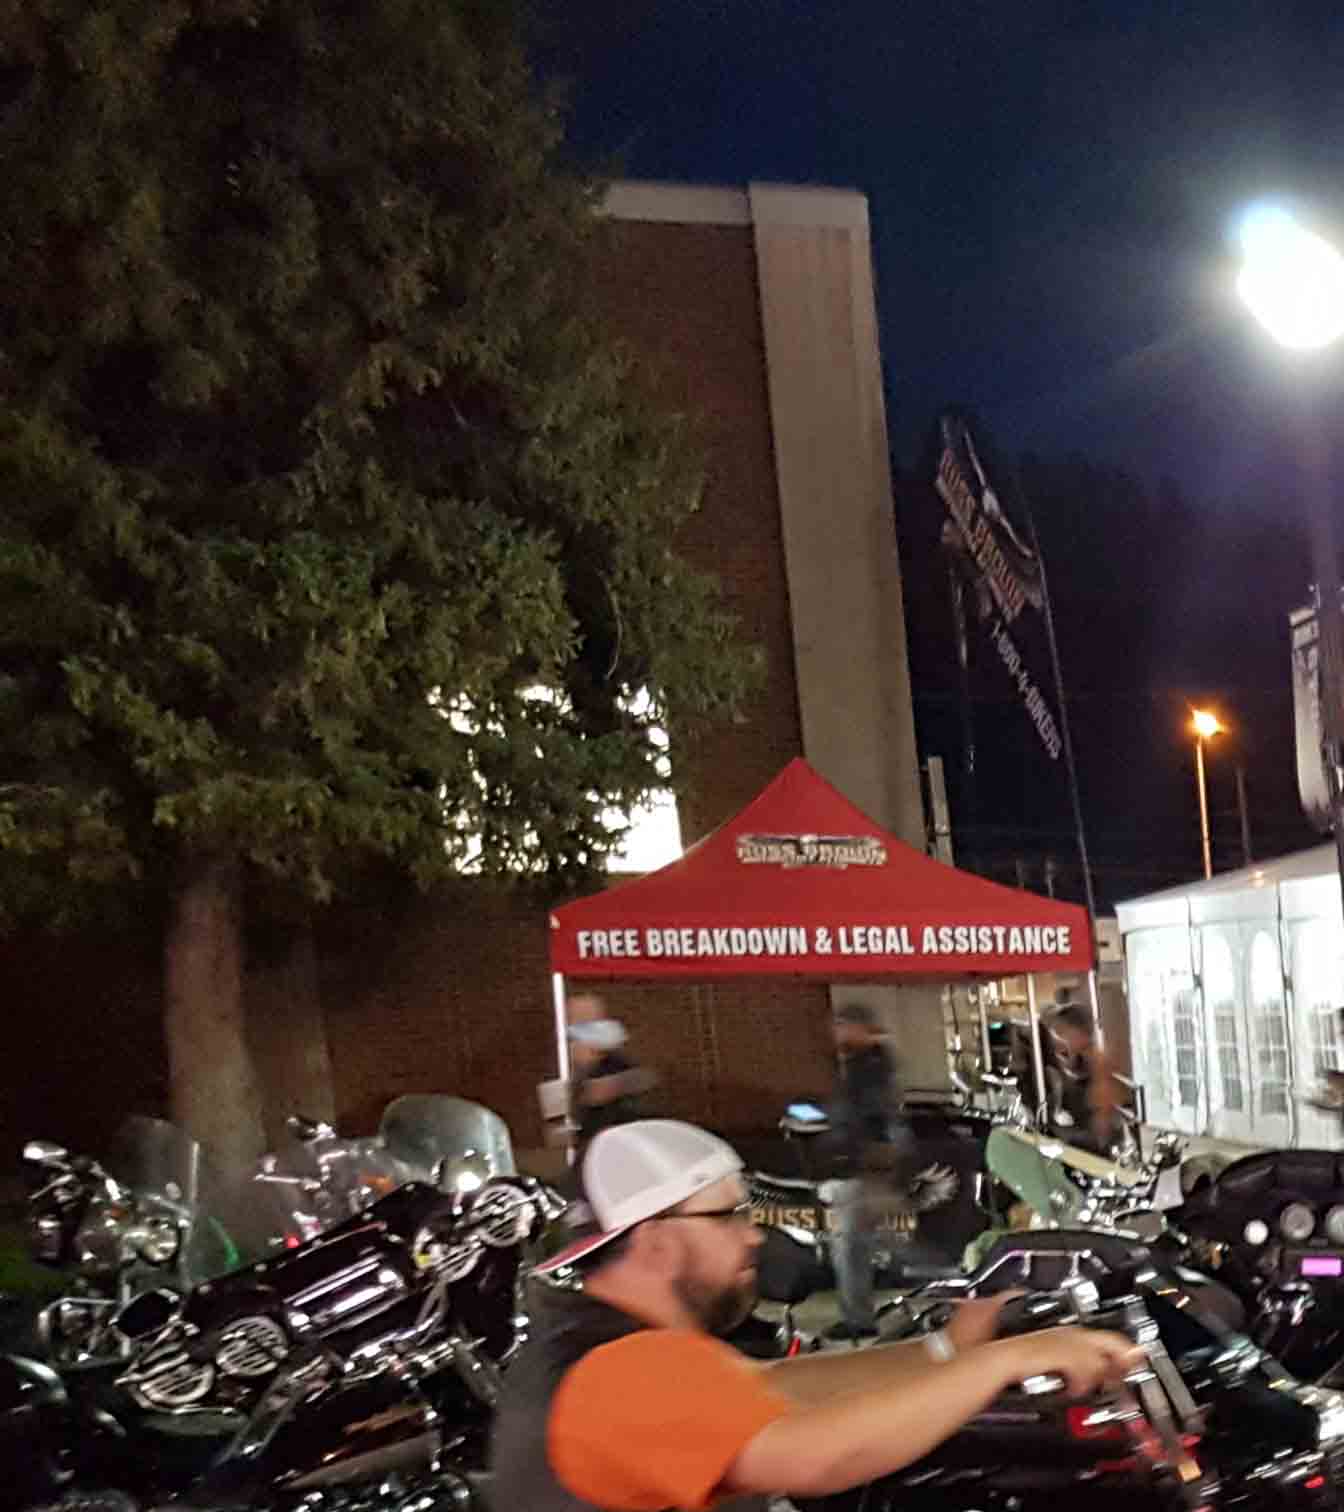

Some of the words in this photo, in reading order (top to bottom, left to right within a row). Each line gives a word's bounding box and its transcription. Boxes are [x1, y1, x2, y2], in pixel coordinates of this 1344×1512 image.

[576, 929, 641, 958] FREE
[646, 926, 807, 957] BREAKDOWN
[815, 928, 832, 955] &
[838, 926, 915, 955] LEGAL
[921, 925, 1071, 956] ASSISTANCE
